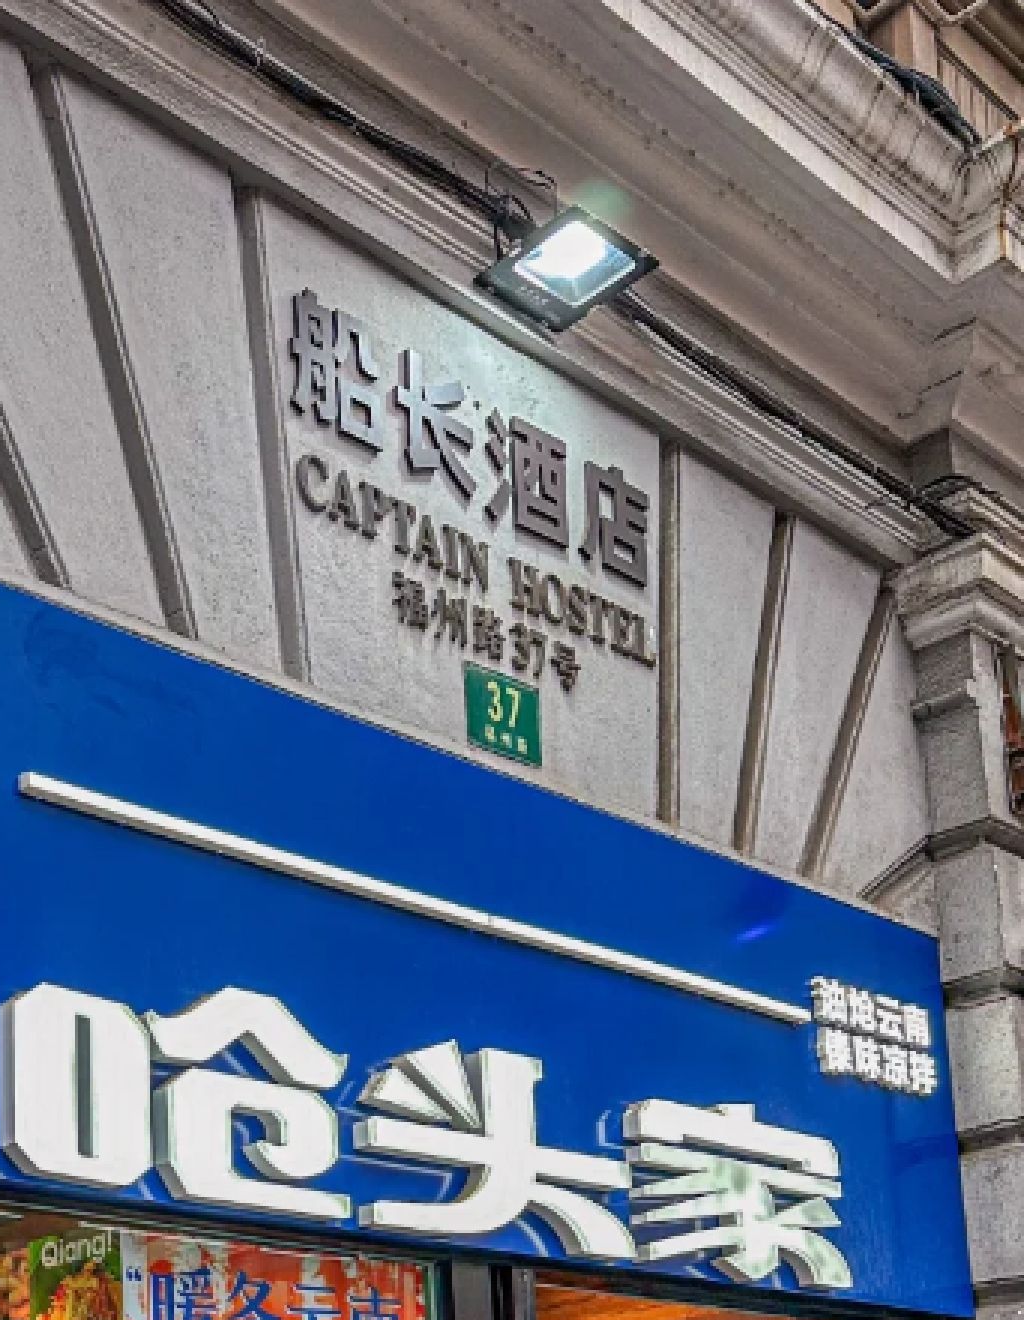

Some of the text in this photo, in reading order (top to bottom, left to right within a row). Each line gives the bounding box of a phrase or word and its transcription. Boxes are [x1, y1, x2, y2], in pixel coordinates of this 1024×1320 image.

[290, 288, 652, 589] 船长酒店
[295, 455, 657, 669] CAPTAIN HOSTEL
[486, 681, 520, 728] 37
[40, 1230, 113, 1268] Qiang!
